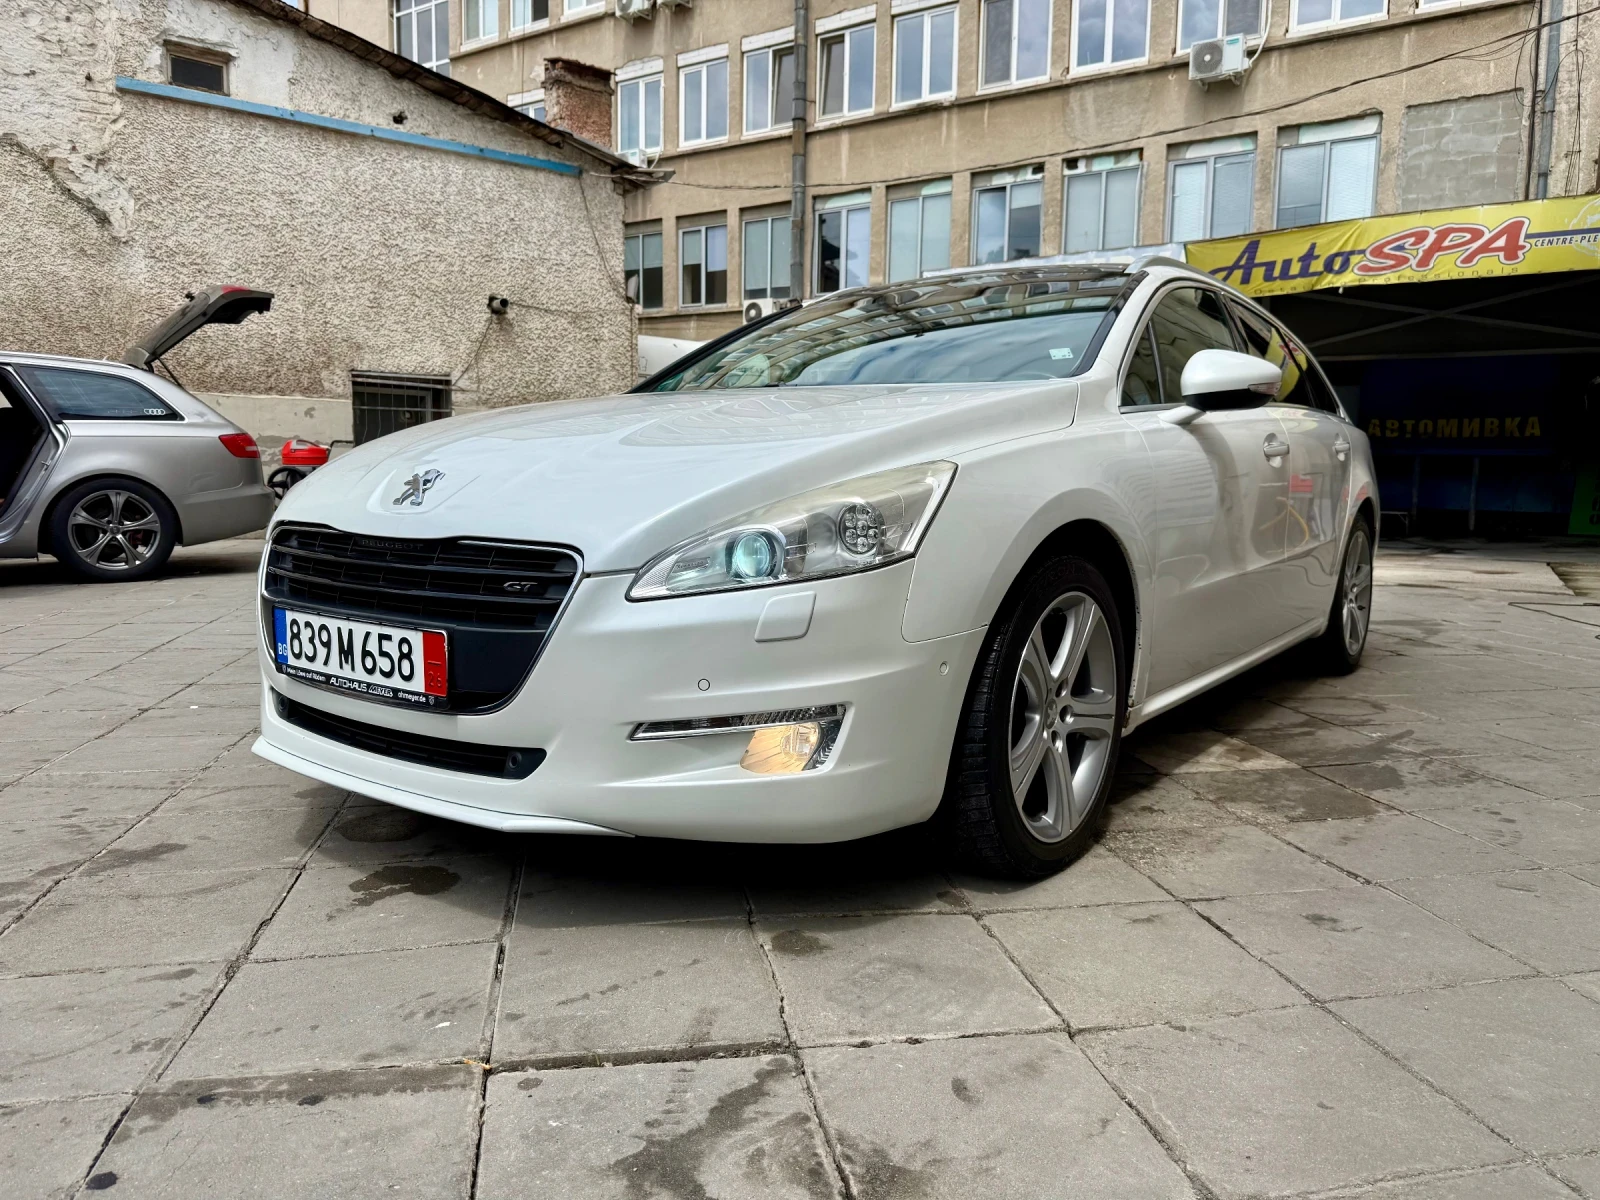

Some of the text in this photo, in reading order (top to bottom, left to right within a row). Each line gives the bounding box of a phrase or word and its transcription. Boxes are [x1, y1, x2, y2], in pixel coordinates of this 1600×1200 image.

[1368, 416, 1541, 439] АВТОМИВКА
[362, 539, 424, 551] PEUGEOT
[503, 580, 538, 592] GT
[278, 642, 288, 656] BG
[329, 677, 368, 692] AUTOHAUS
